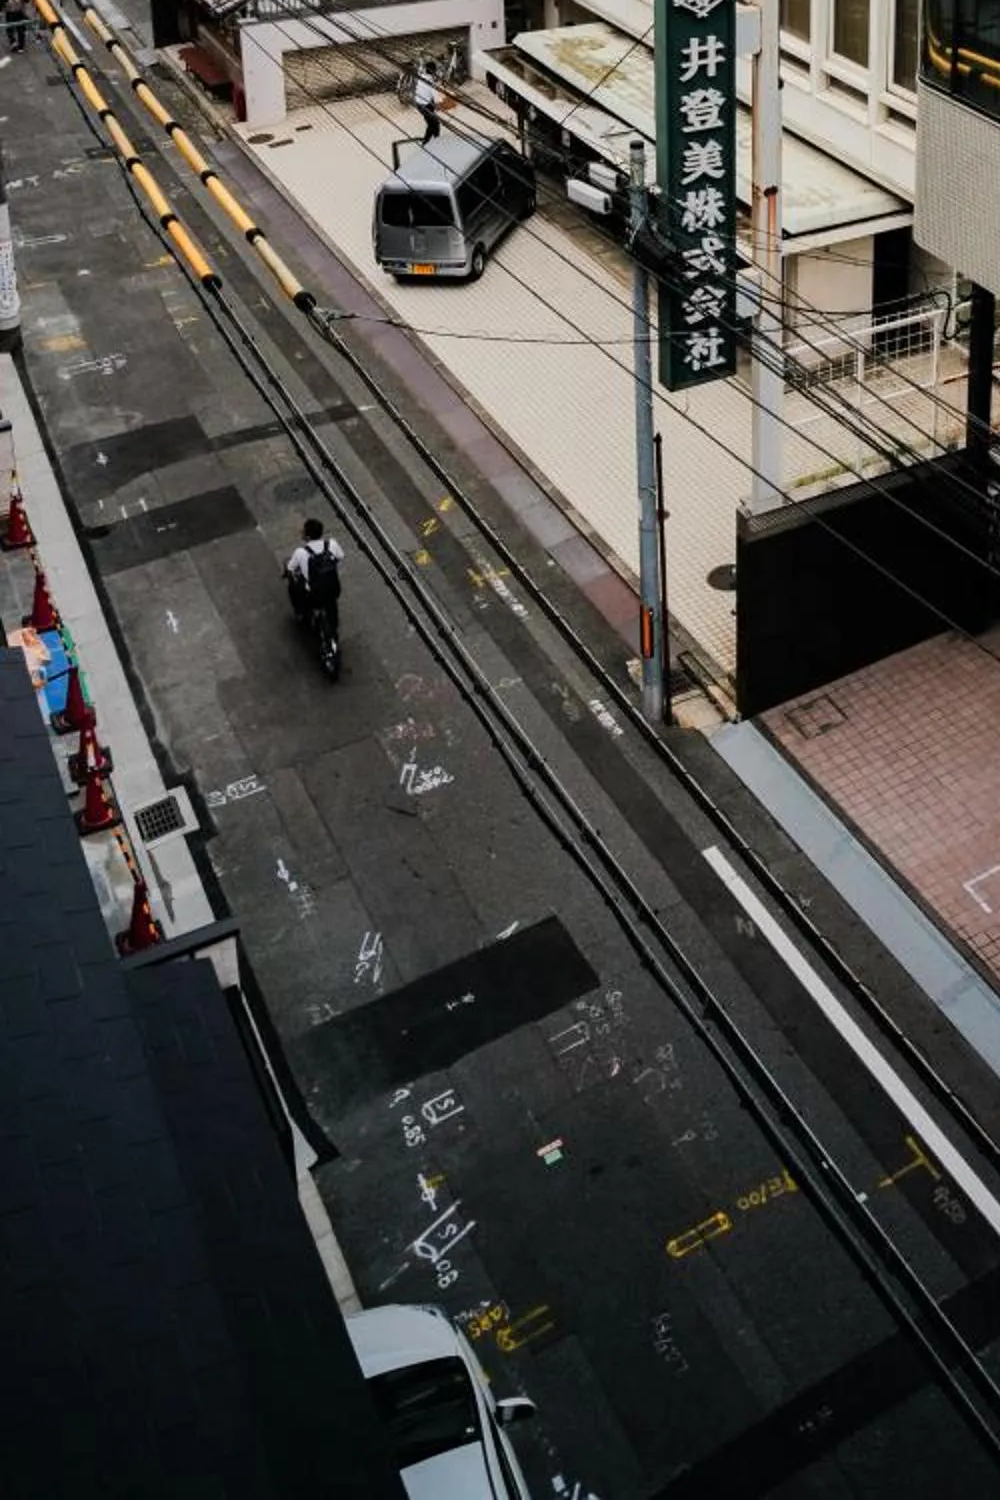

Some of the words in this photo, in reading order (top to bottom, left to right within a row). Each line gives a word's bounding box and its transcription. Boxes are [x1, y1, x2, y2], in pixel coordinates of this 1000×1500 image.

[679, 34, 727, 371] 井登美株式会社
